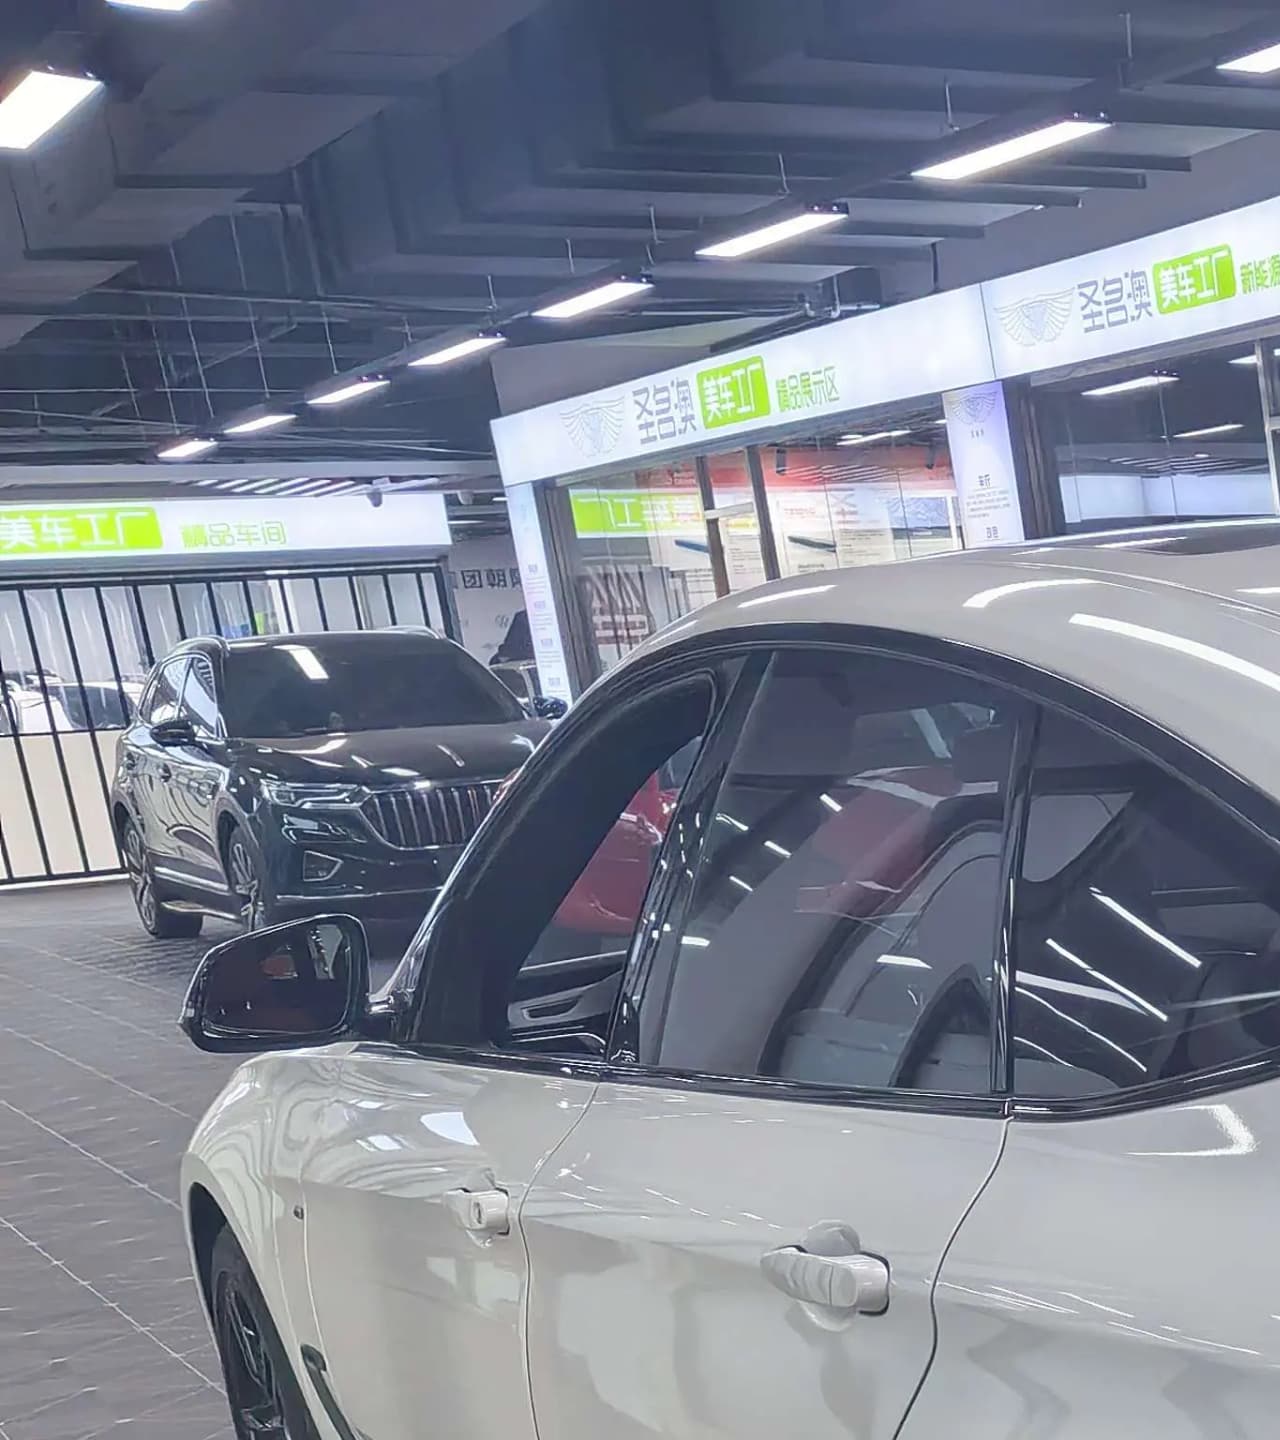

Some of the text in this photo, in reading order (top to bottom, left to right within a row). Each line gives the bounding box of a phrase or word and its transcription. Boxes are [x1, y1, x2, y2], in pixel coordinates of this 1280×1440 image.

[1159, 249, 1231, 309] 美车工厂
[702, 363, 762, 423] 美车工厂
[776, 366, 841, 413] 精品展示区
[0, 510, 288, 550] 美车工厂 精品车间
